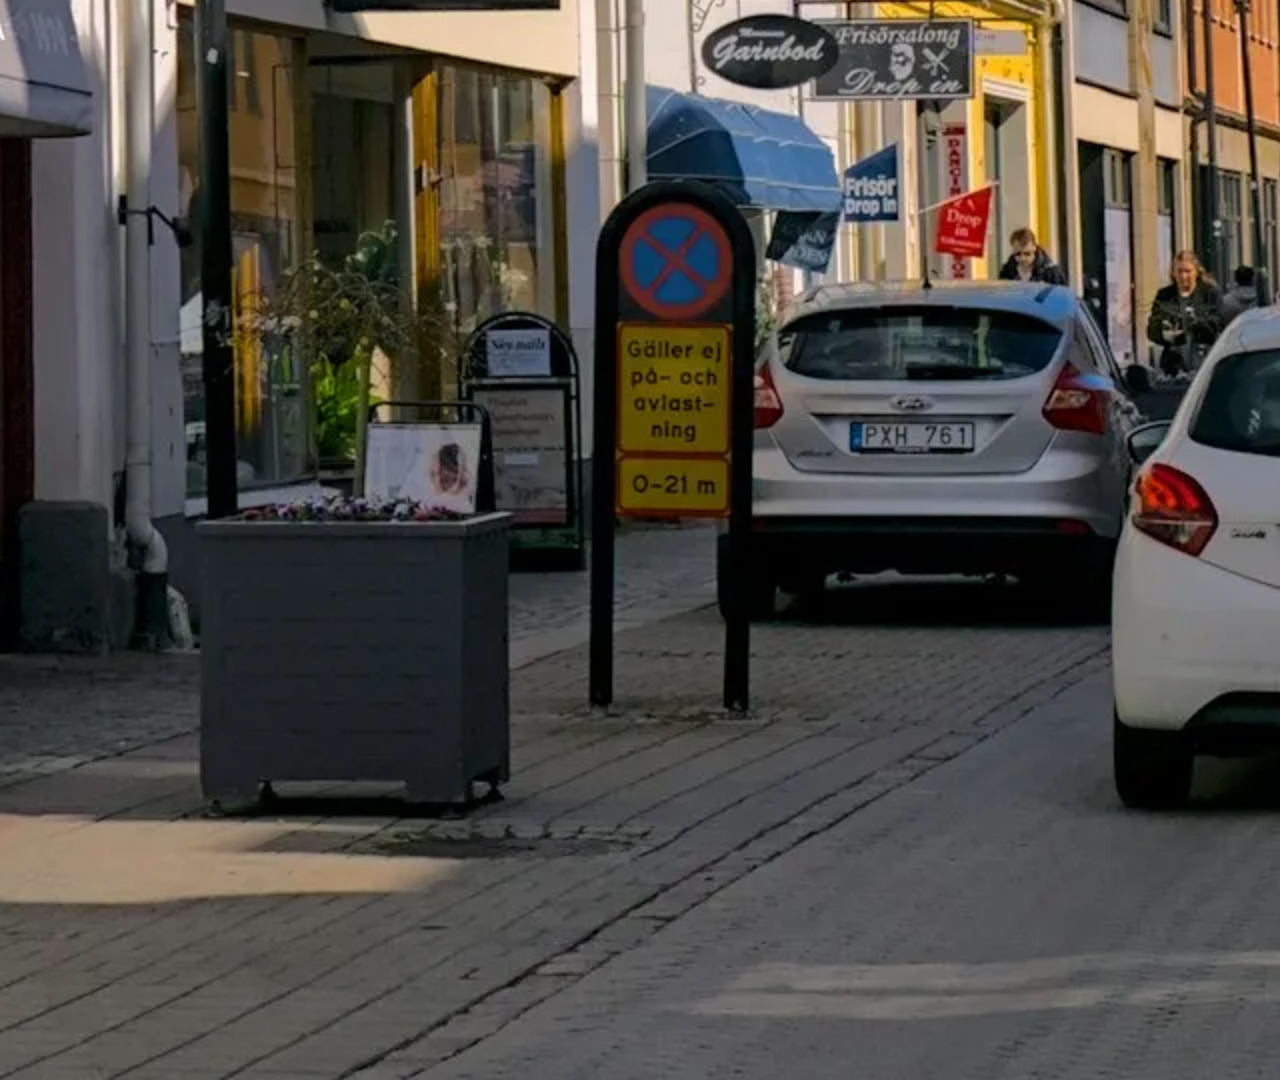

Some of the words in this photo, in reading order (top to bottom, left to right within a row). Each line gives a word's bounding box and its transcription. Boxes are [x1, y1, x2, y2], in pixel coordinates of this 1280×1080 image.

[837, 24, 961, 48] Frisörsalong
[713, 33, 826, 71] Garnbod
[837, 67, 921, 98] Drop
[929, 74, 962, 94] in
[844, 174, 897, 198] Frisör
[844, 199, 881, 215] Drop
[883, 198, 897, 213] in
[946, 208, 983, 229] Drop
[954, 223, 969, 238] in
[627, 339, 694, 360] Gäller
[702, 340, 723, 364] ej
[631, 366, 671, 391] på-
[680, 369, 718, 387] och
[633, 392, 715, 413] avlast-
[650, 419, 697, 444] ning
[864, 425, 908, 445] PXH
[925, 426, 967, 446] 761
[632, 474, 690, 495] 0-21
[697, 479, 716, 495] m
